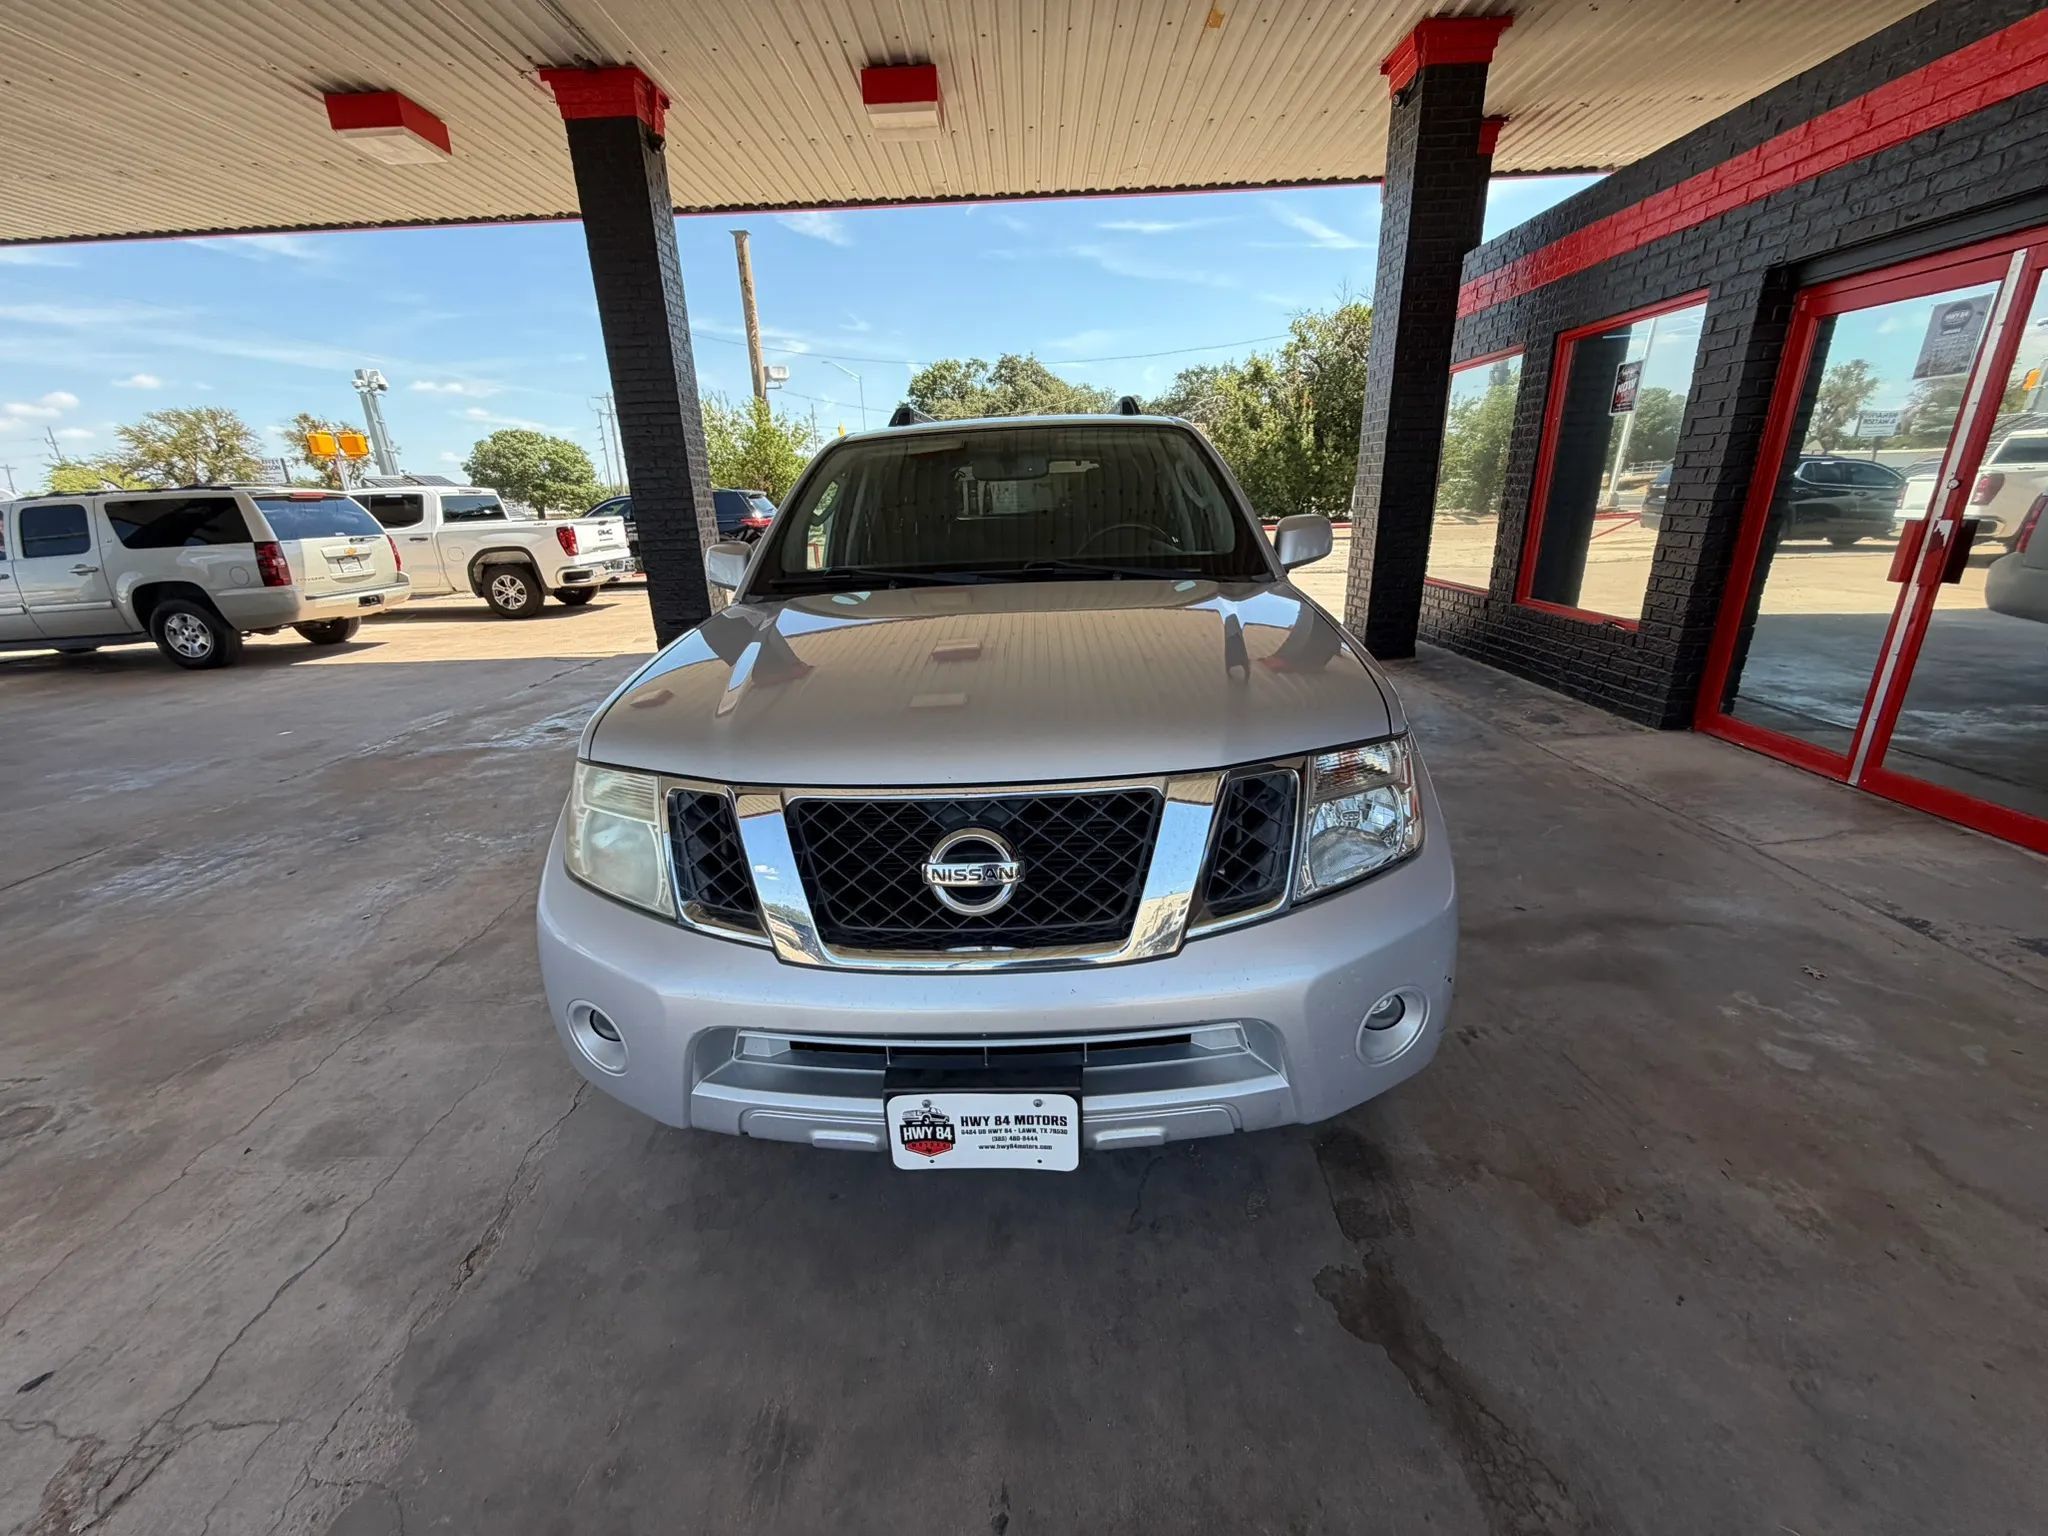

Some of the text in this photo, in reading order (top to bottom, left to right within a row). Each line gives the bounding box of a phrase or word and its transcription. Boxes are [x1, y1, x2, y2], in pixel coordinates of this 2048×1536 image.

[931, 866, 1014, 882] NISSAN
[960, 1114, 1068, 1127] HWY 84 MOTORS
[903, 1126, 952, 1141] HWY 84
